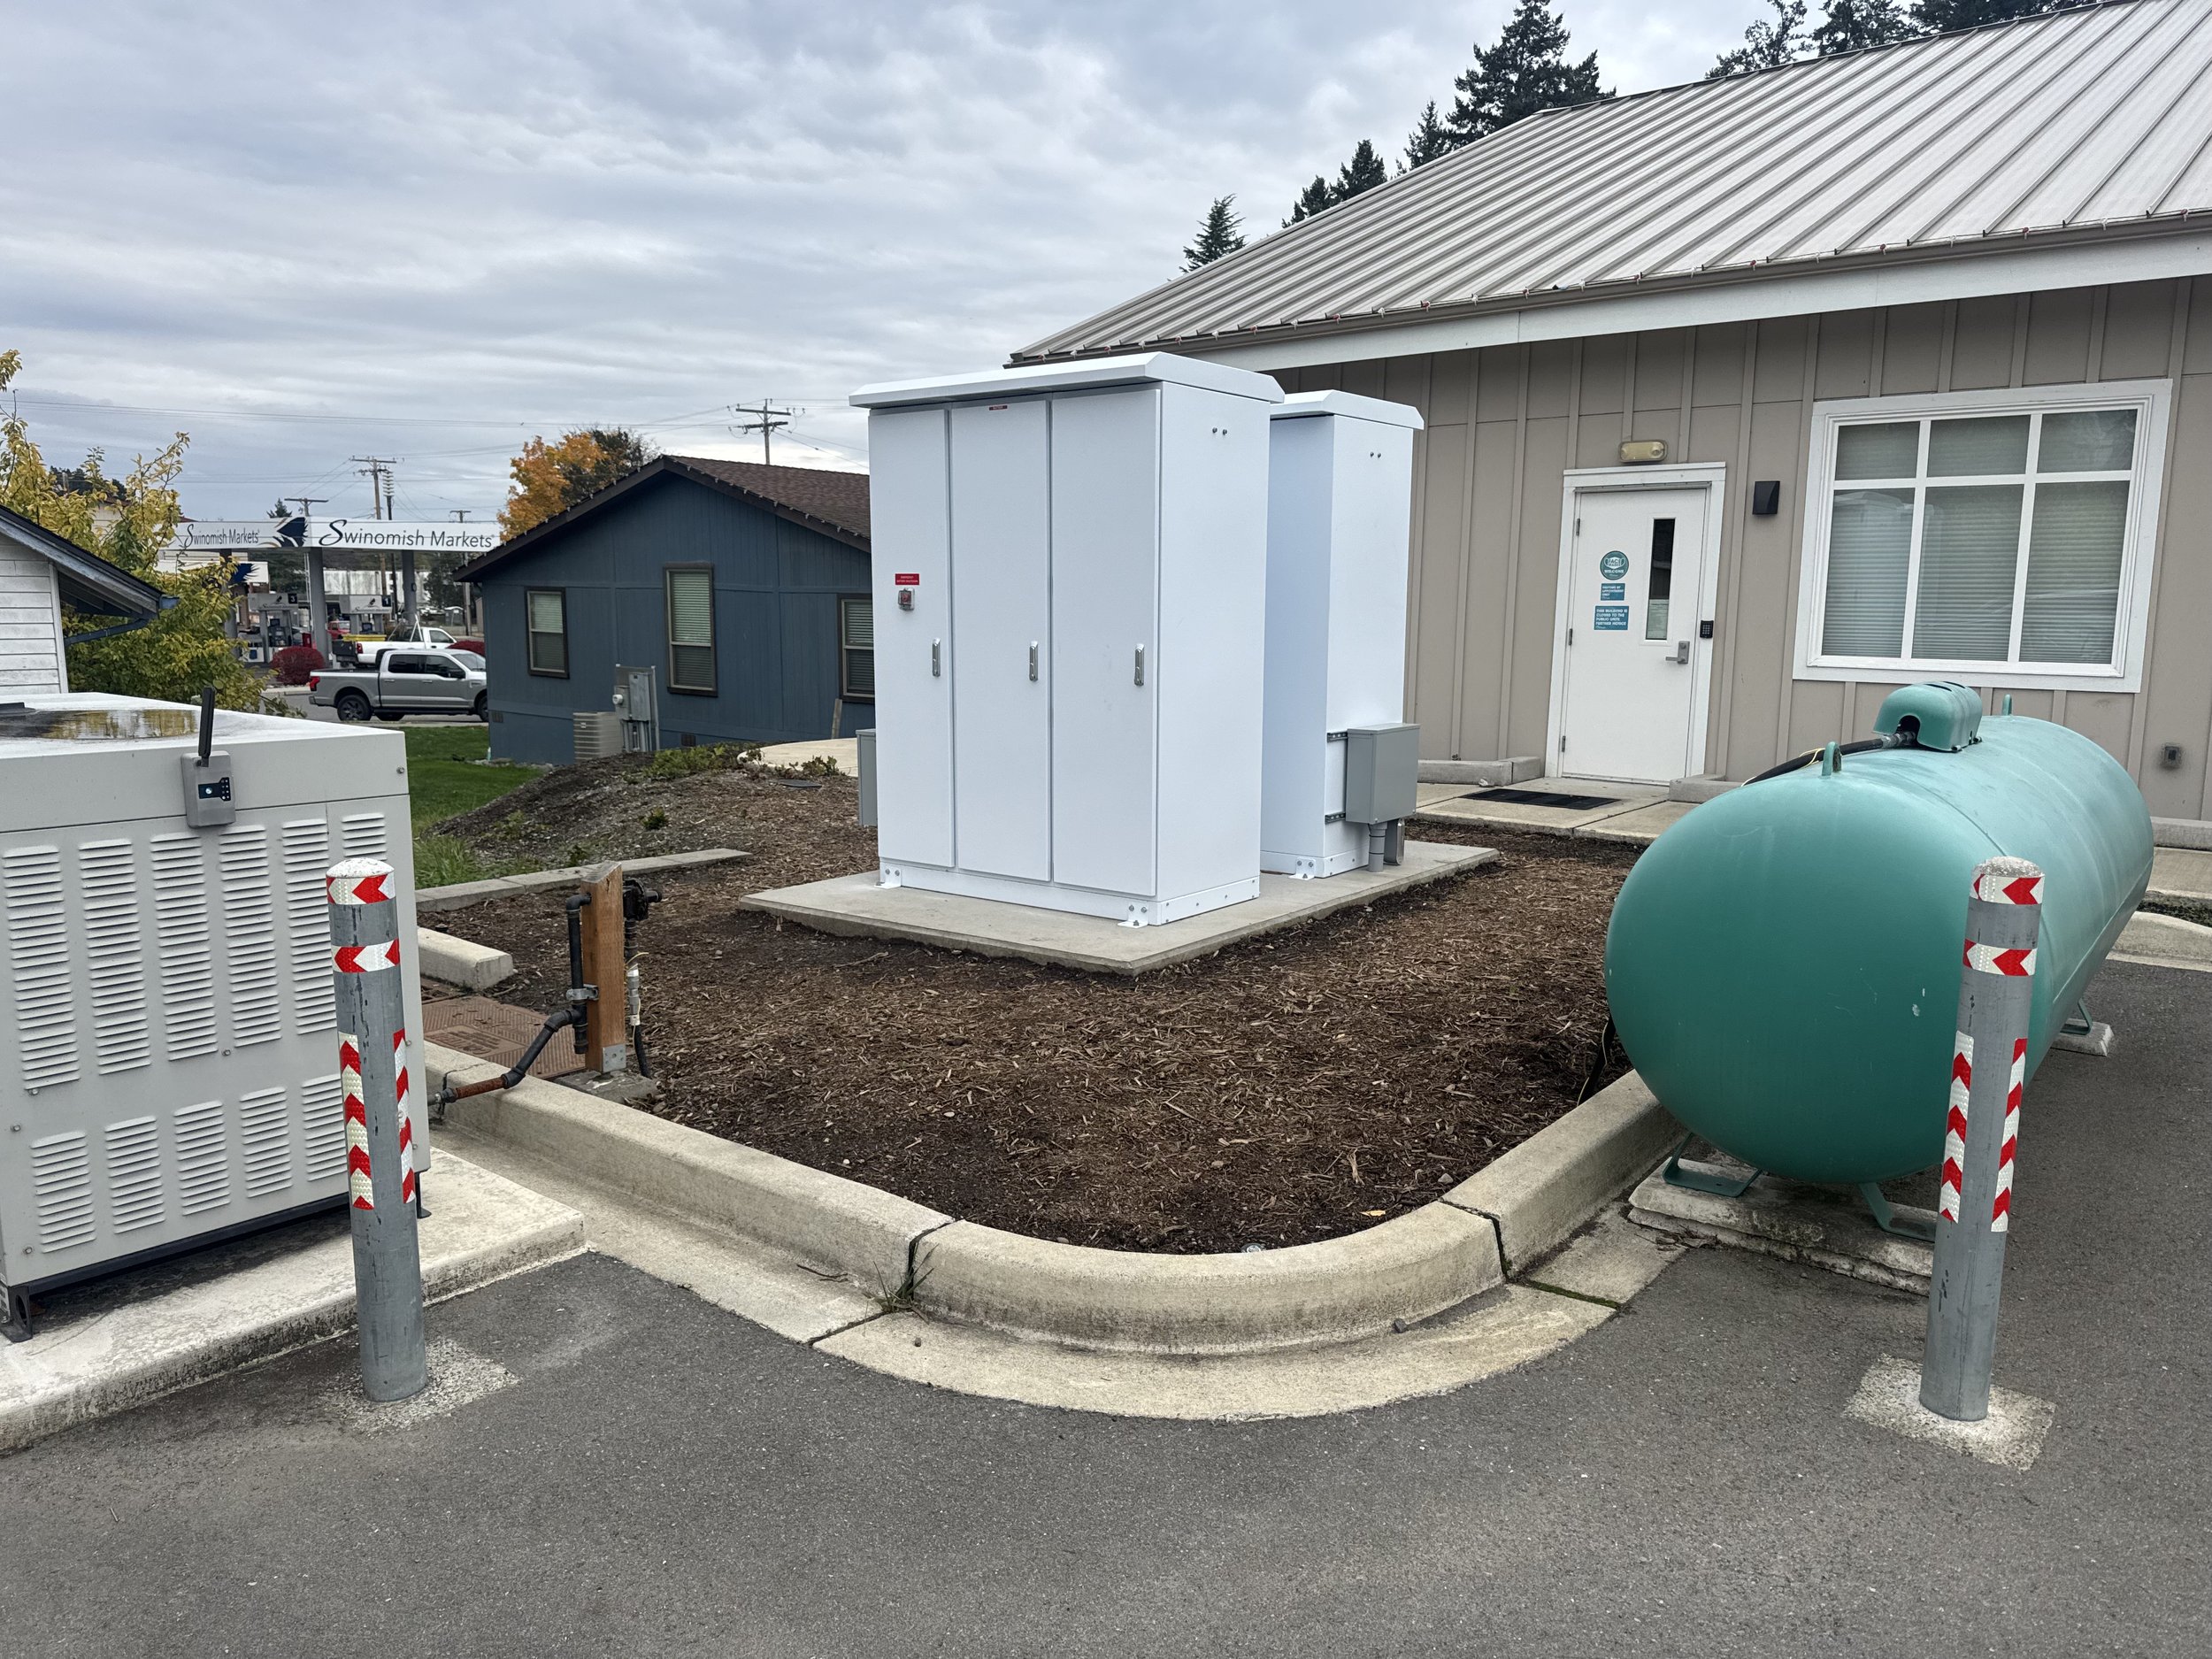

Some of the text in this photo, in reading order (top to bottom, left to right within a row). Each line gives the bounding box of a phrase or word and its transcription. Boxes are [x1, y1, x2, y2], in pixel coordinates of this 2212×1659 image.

[183, 523, 259, 548] Swinomish Markets
[319, 518, 493, 548] Swinomish Markets
